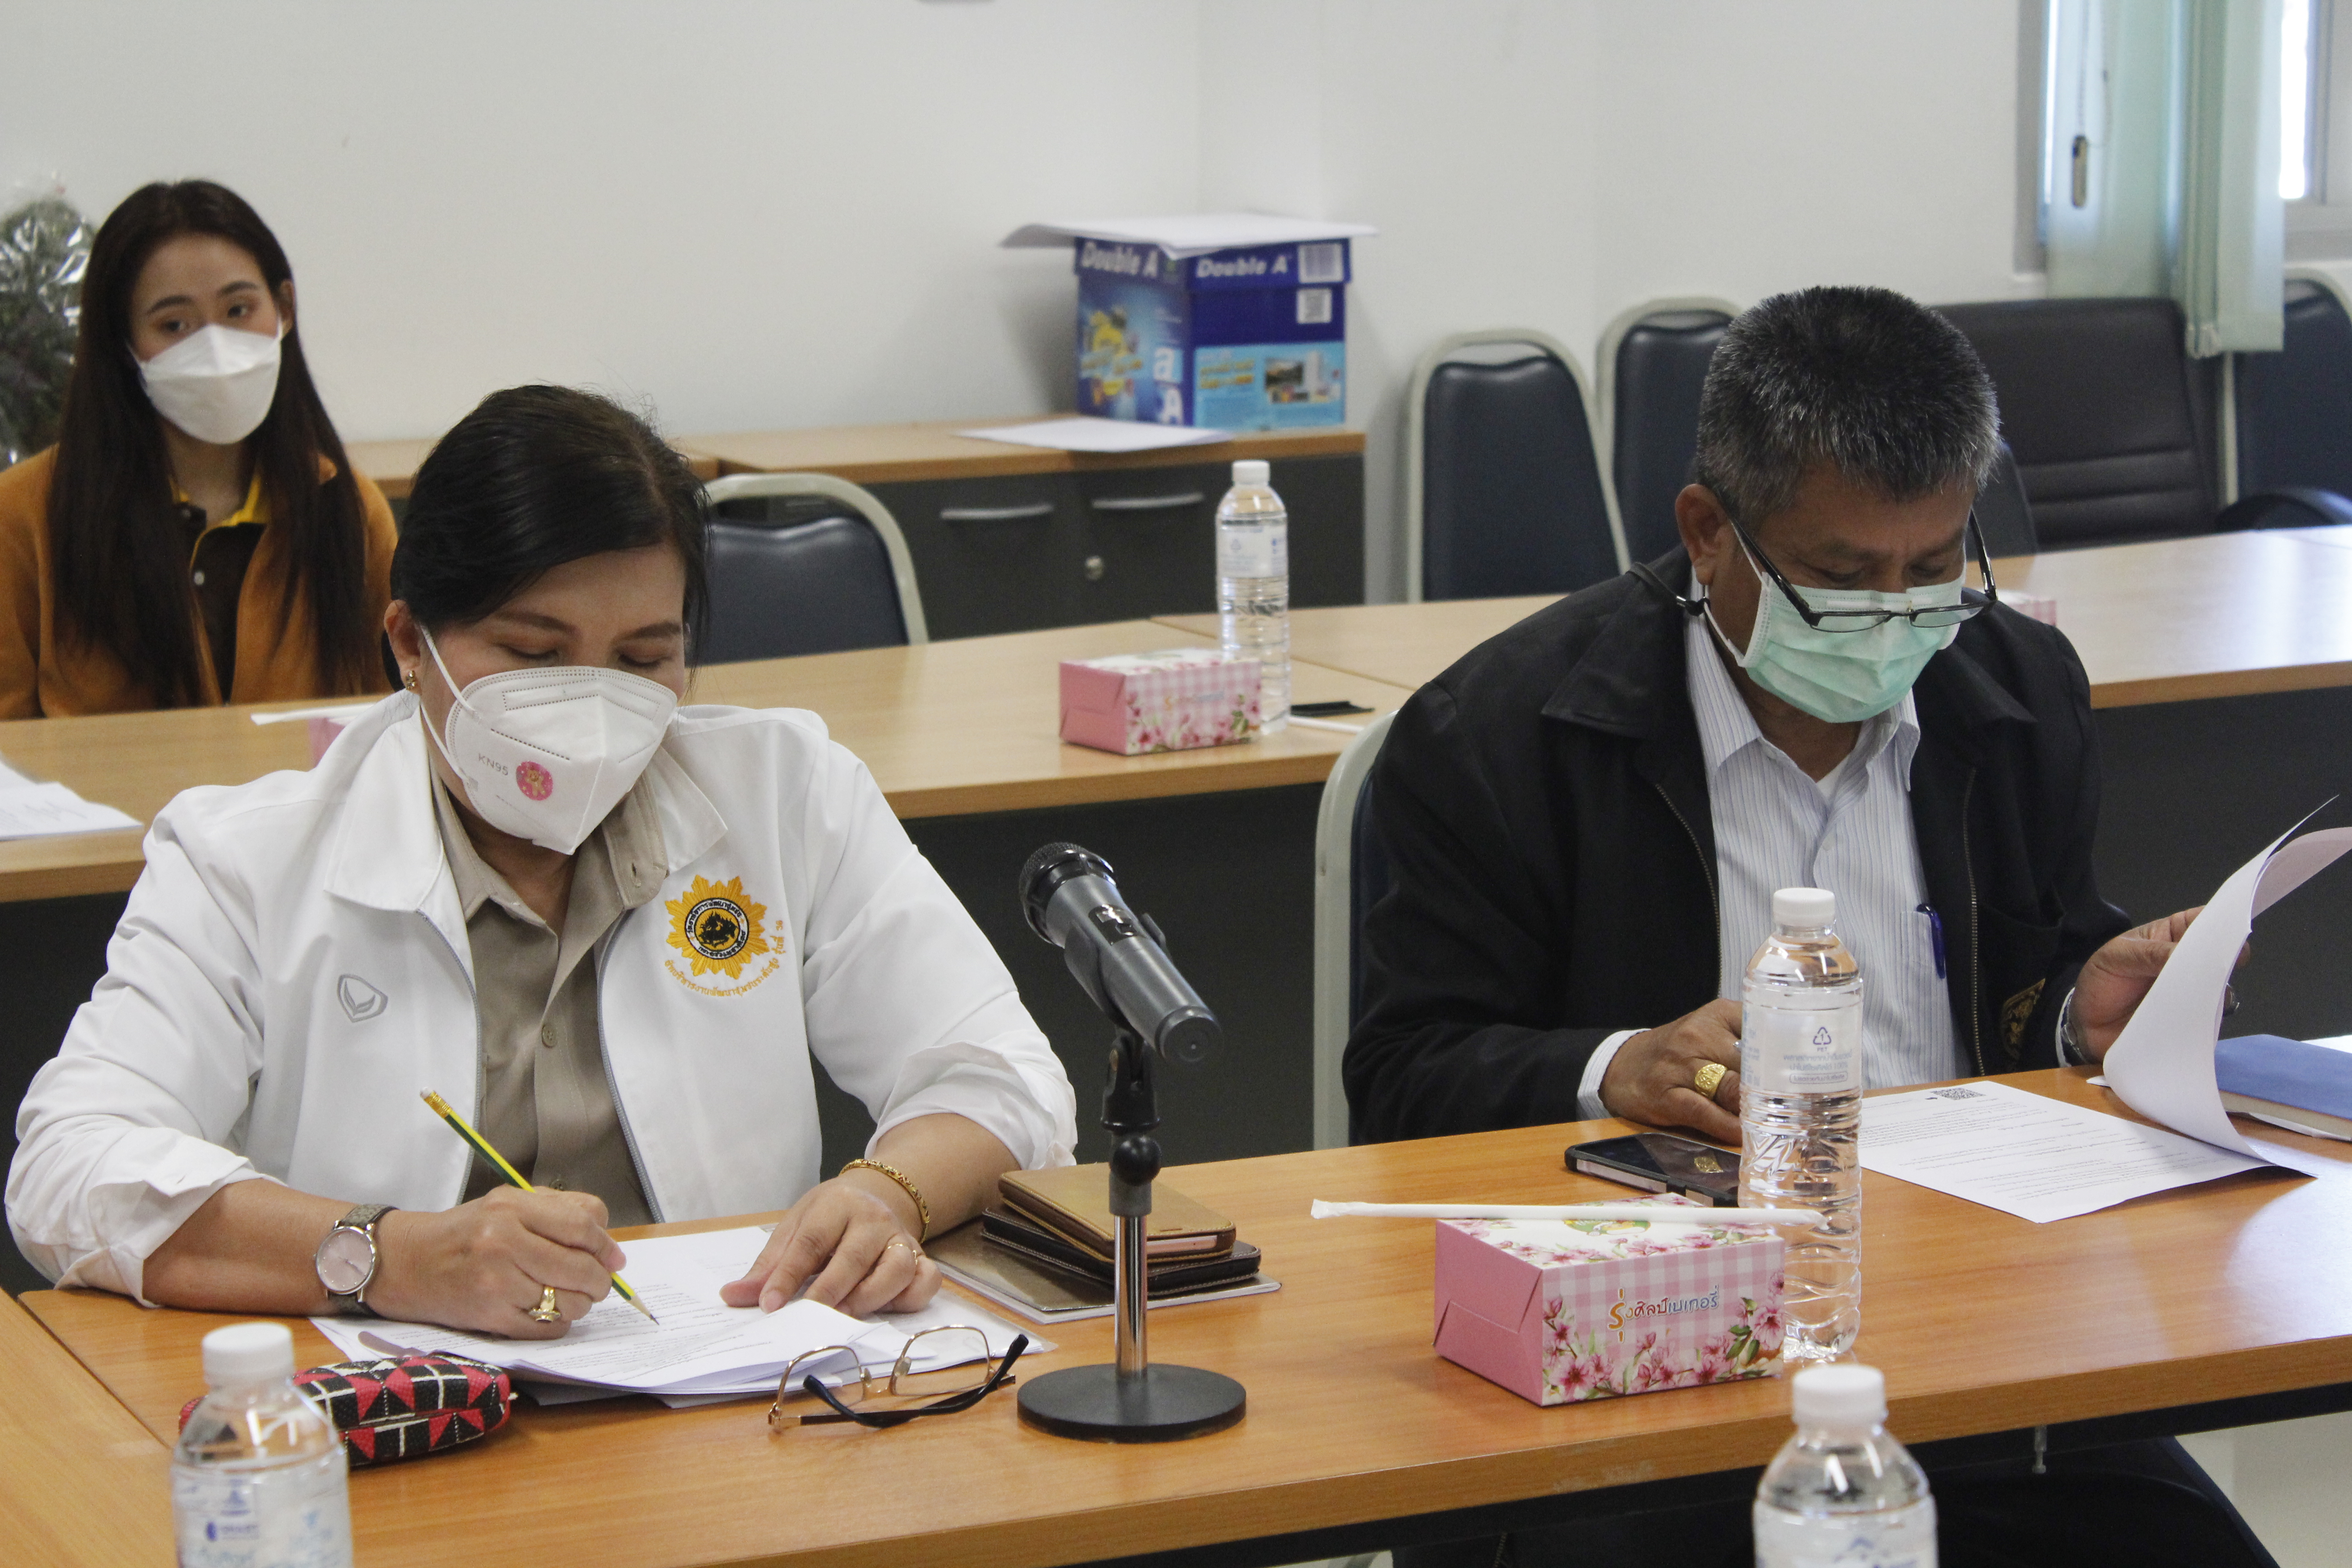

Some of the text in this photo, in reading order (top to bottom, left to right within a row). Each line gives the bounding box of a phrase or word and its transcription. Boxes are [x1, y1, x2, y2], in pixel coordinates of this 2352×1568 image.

[1082, 241, 1159, 277] Double A
[1196, 255, 1289, 278] Double A
[478, 753, 509, 776] KN95
[1608, 1284, 1720, 1343] รุ่งศิลป์เบเกอรี่
